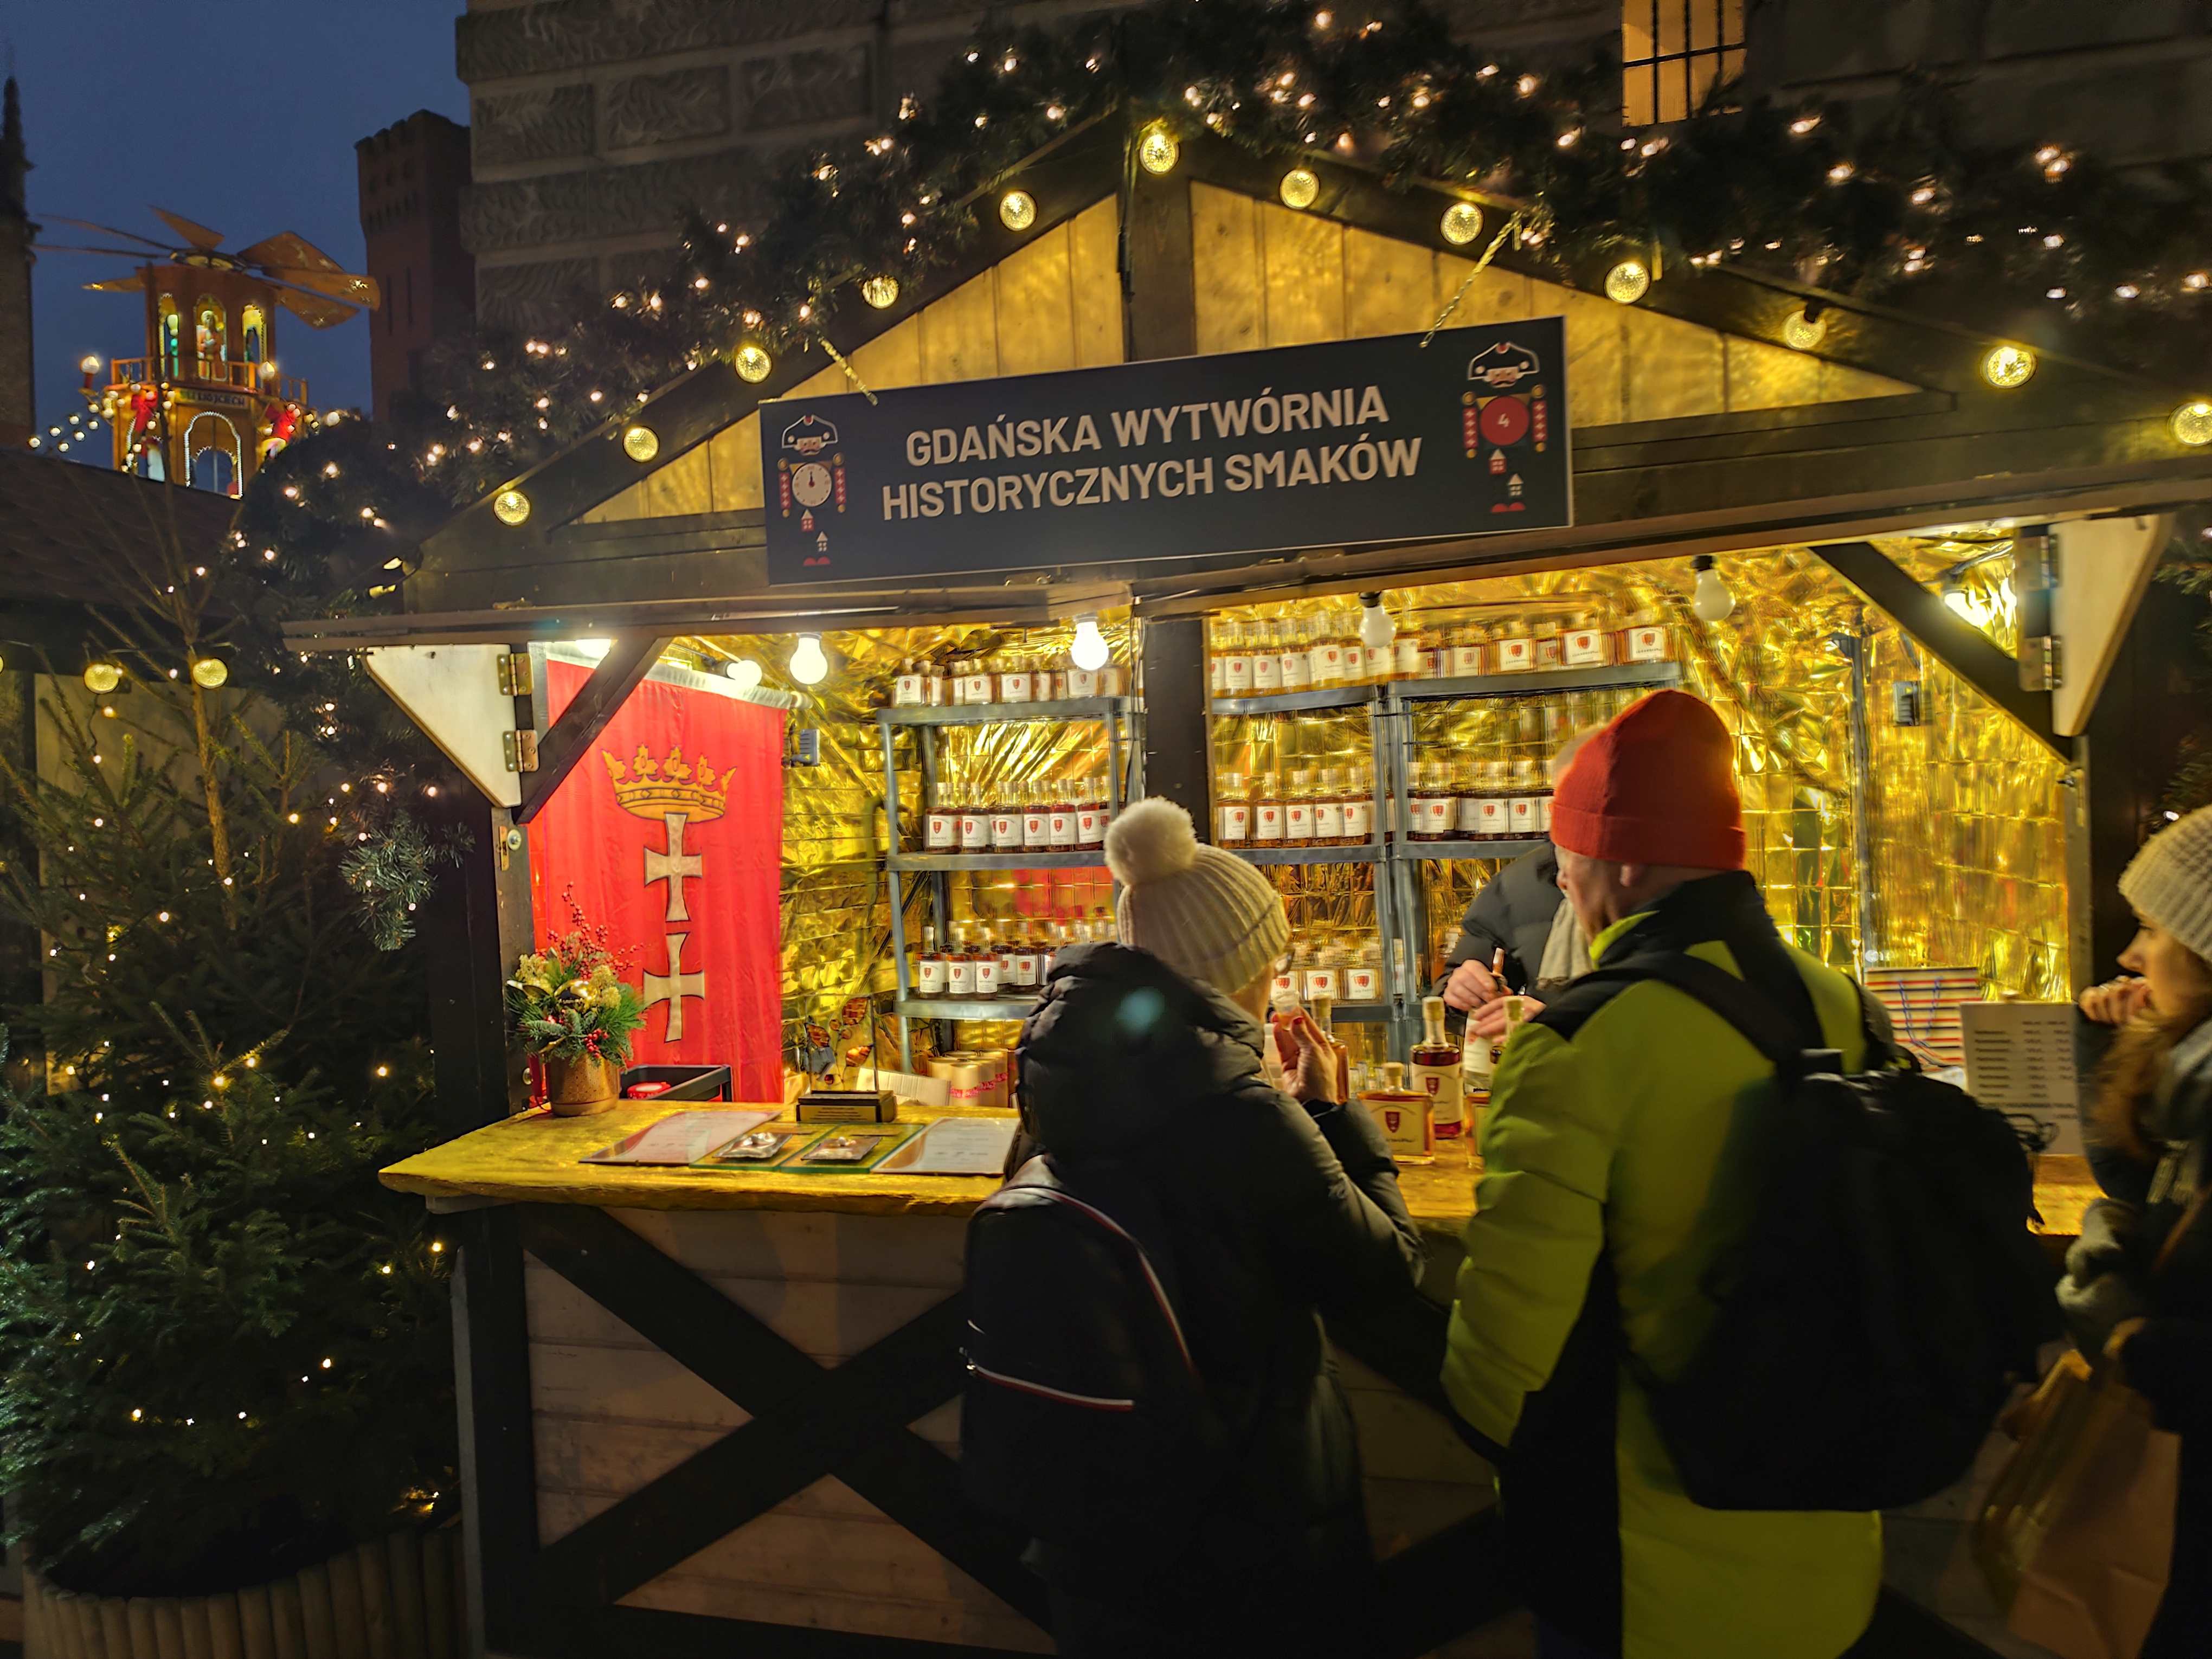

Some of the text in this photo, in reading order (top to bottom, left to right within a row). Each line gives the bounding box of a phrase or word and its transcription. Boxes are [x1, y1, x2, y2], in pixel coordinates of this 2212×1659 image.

[906, 385, 1390, 467] GDAŃSKA WYTWÓRNIA
[1498, 413, 1510, 428] 4
[882, 433, 1423, 520] HISTORYCZNYCH SMAKÓW
